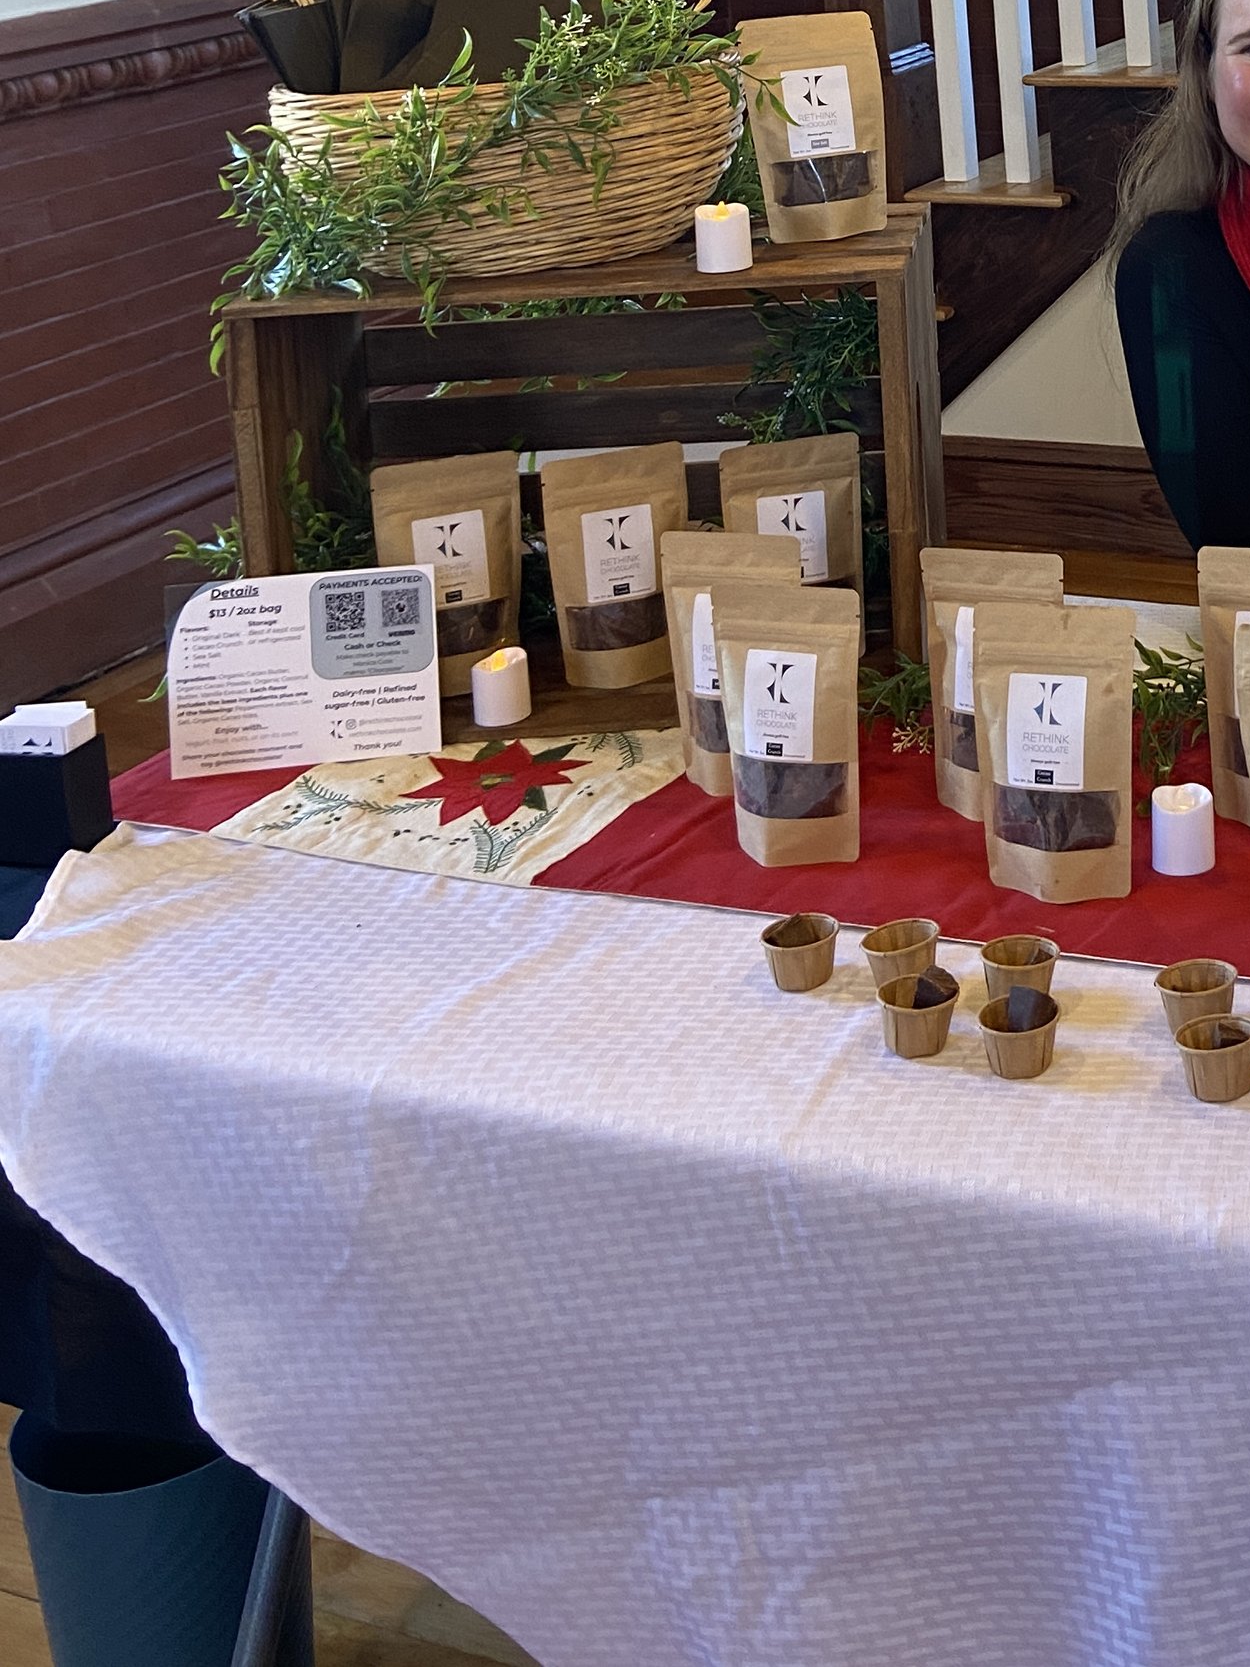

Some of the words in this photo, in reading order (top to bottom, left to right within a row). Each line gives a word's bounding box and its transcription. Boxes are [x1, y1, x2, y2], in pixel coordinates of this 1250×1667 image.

[797, 111, 838, 122] RETHINK
[318, 579, 369, 590] PAYMENTS
[370, 575, 422, 586] ACCEPTED:
[210, 585, 260, 600] Details
[208, 608, 226, 619] $13
[236, 606, 256, 615] 2oz
[258, 605, 282, 614] bag
[332, 688, 376, 698] Dairy-free
[383, 683, 417, 693] Refined
[324, 700, 370, 710] sugar-free
[376, 694, 425, 704] Gluten-free
[756, 708, 798, 722] RETHINK
[382, 740, 402, 750] you!
[1022, 731, 1071, 745] RETHINK
[1021, 743, 1070, 755] CHOCOLATE
